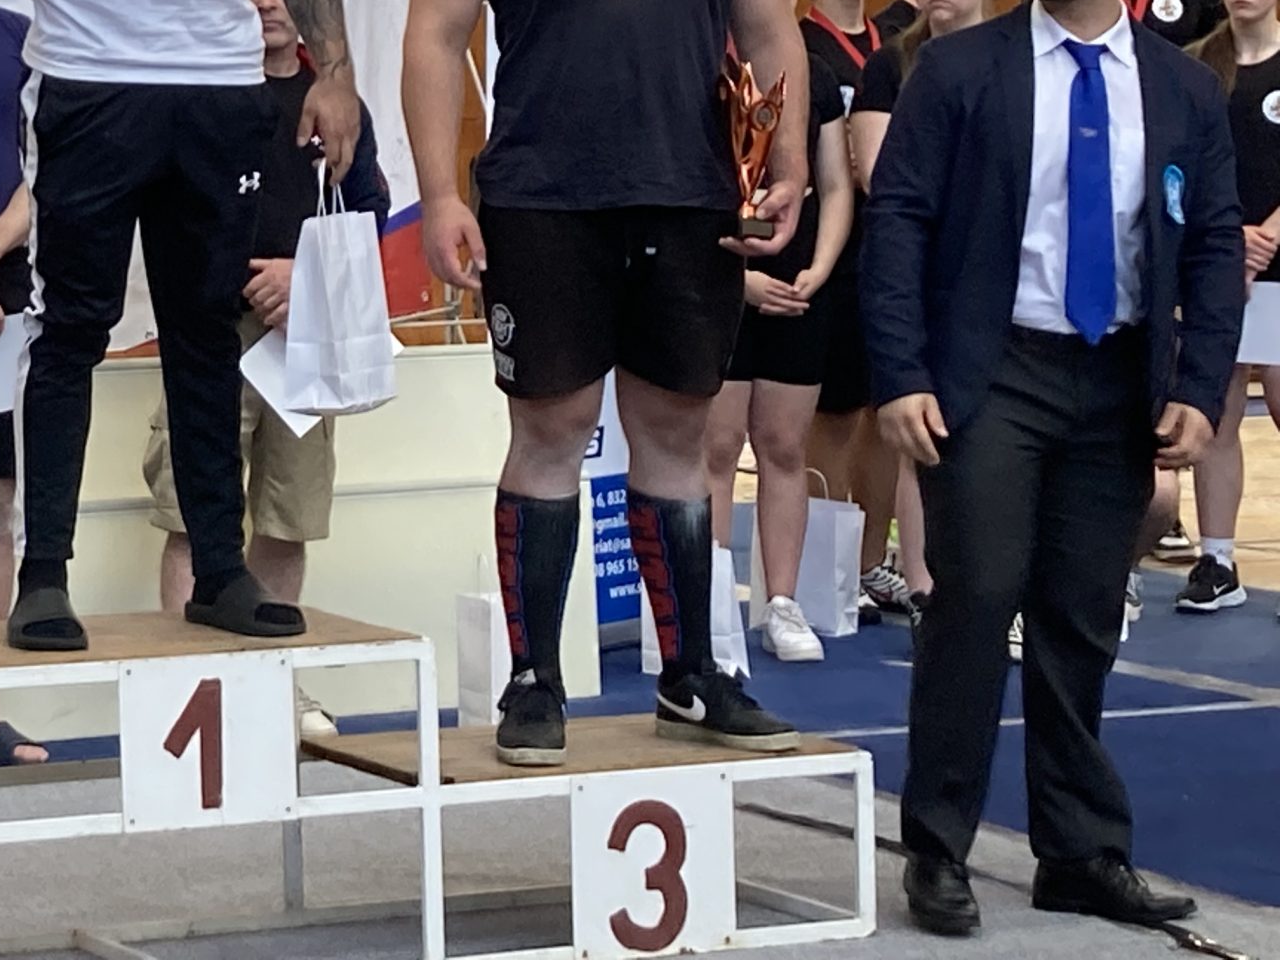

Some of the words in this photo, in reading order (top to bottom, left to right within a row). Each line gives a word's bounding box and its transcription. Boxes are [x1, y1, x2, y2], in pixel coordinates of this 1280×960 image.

[606, 559, 625, 577] 965
[164, 678, 222, 810] 1
[607, 800, 688, 952] 3
